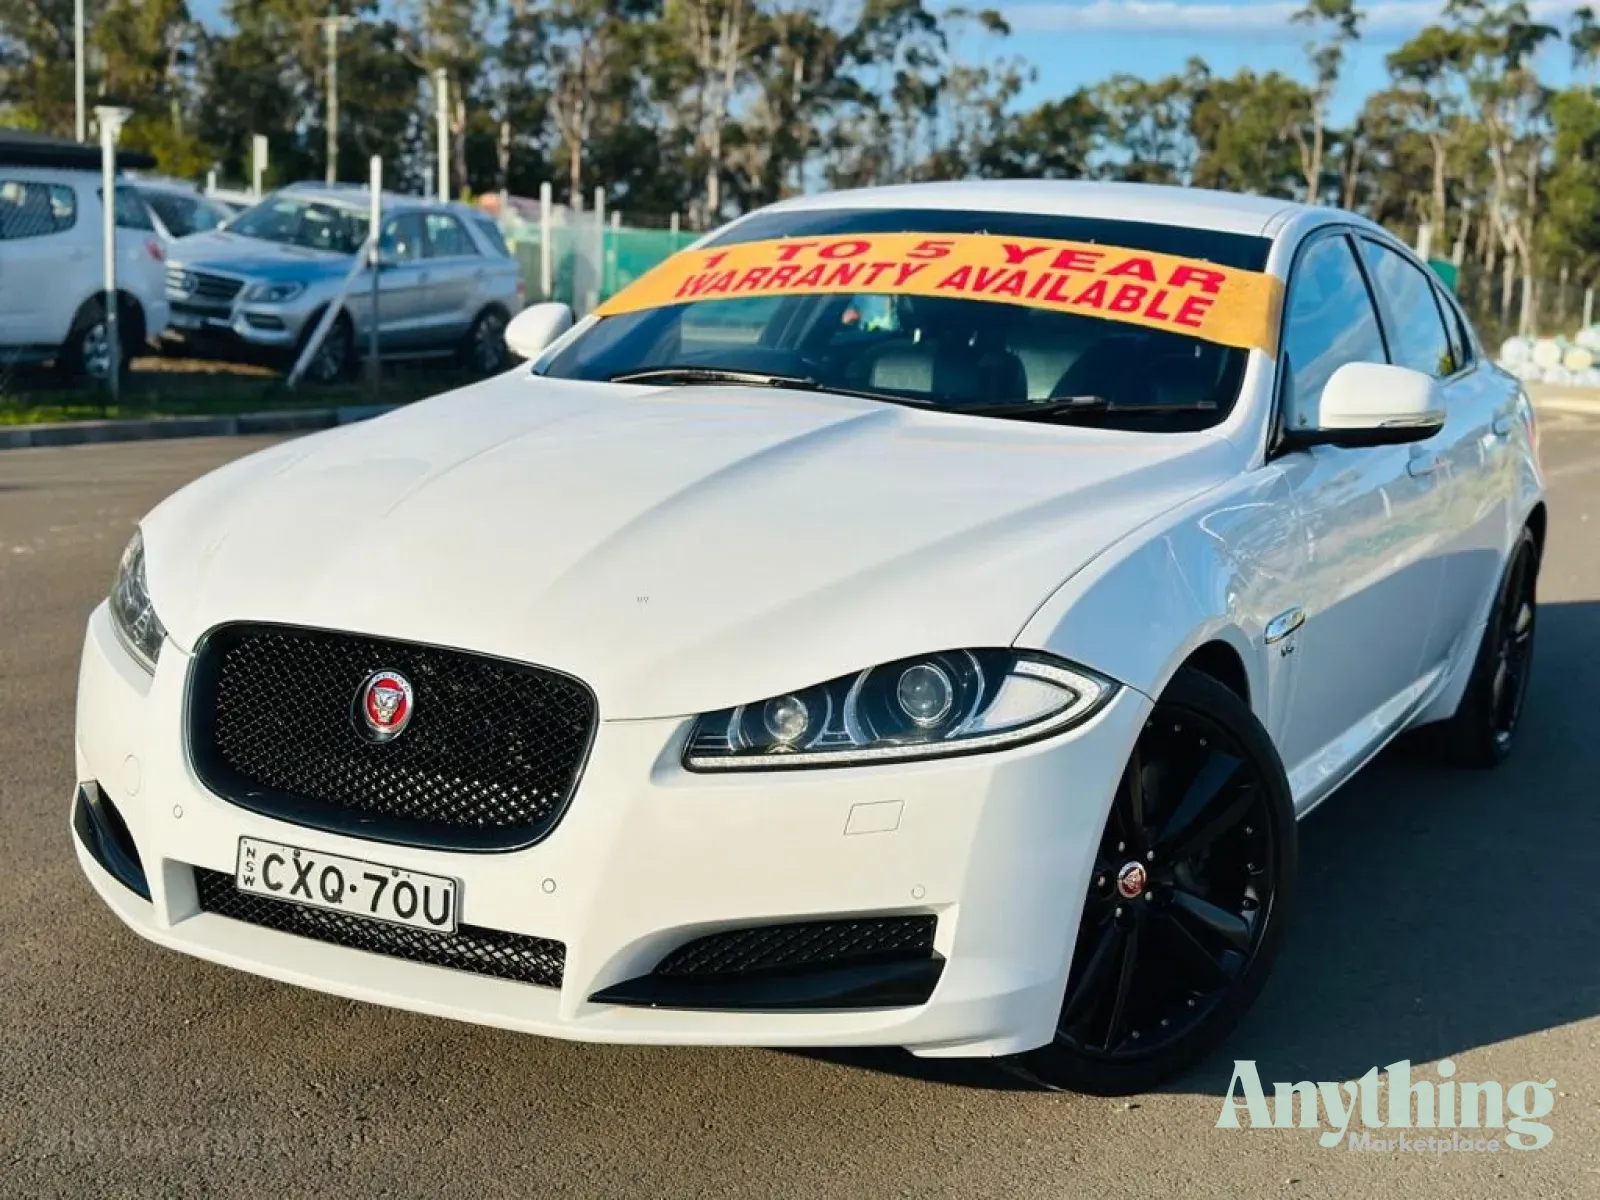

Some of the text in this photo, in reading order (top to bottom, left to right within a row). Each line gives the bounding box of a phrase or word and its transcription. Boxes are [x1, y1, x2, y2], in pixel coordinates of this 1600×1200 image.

[674, 262, 1216, 328] WARRANTY AVAILABLE
[704, 241, 1227, 295] 1 TO 5 YEAR
[243, 846, 256, 887] NSW
